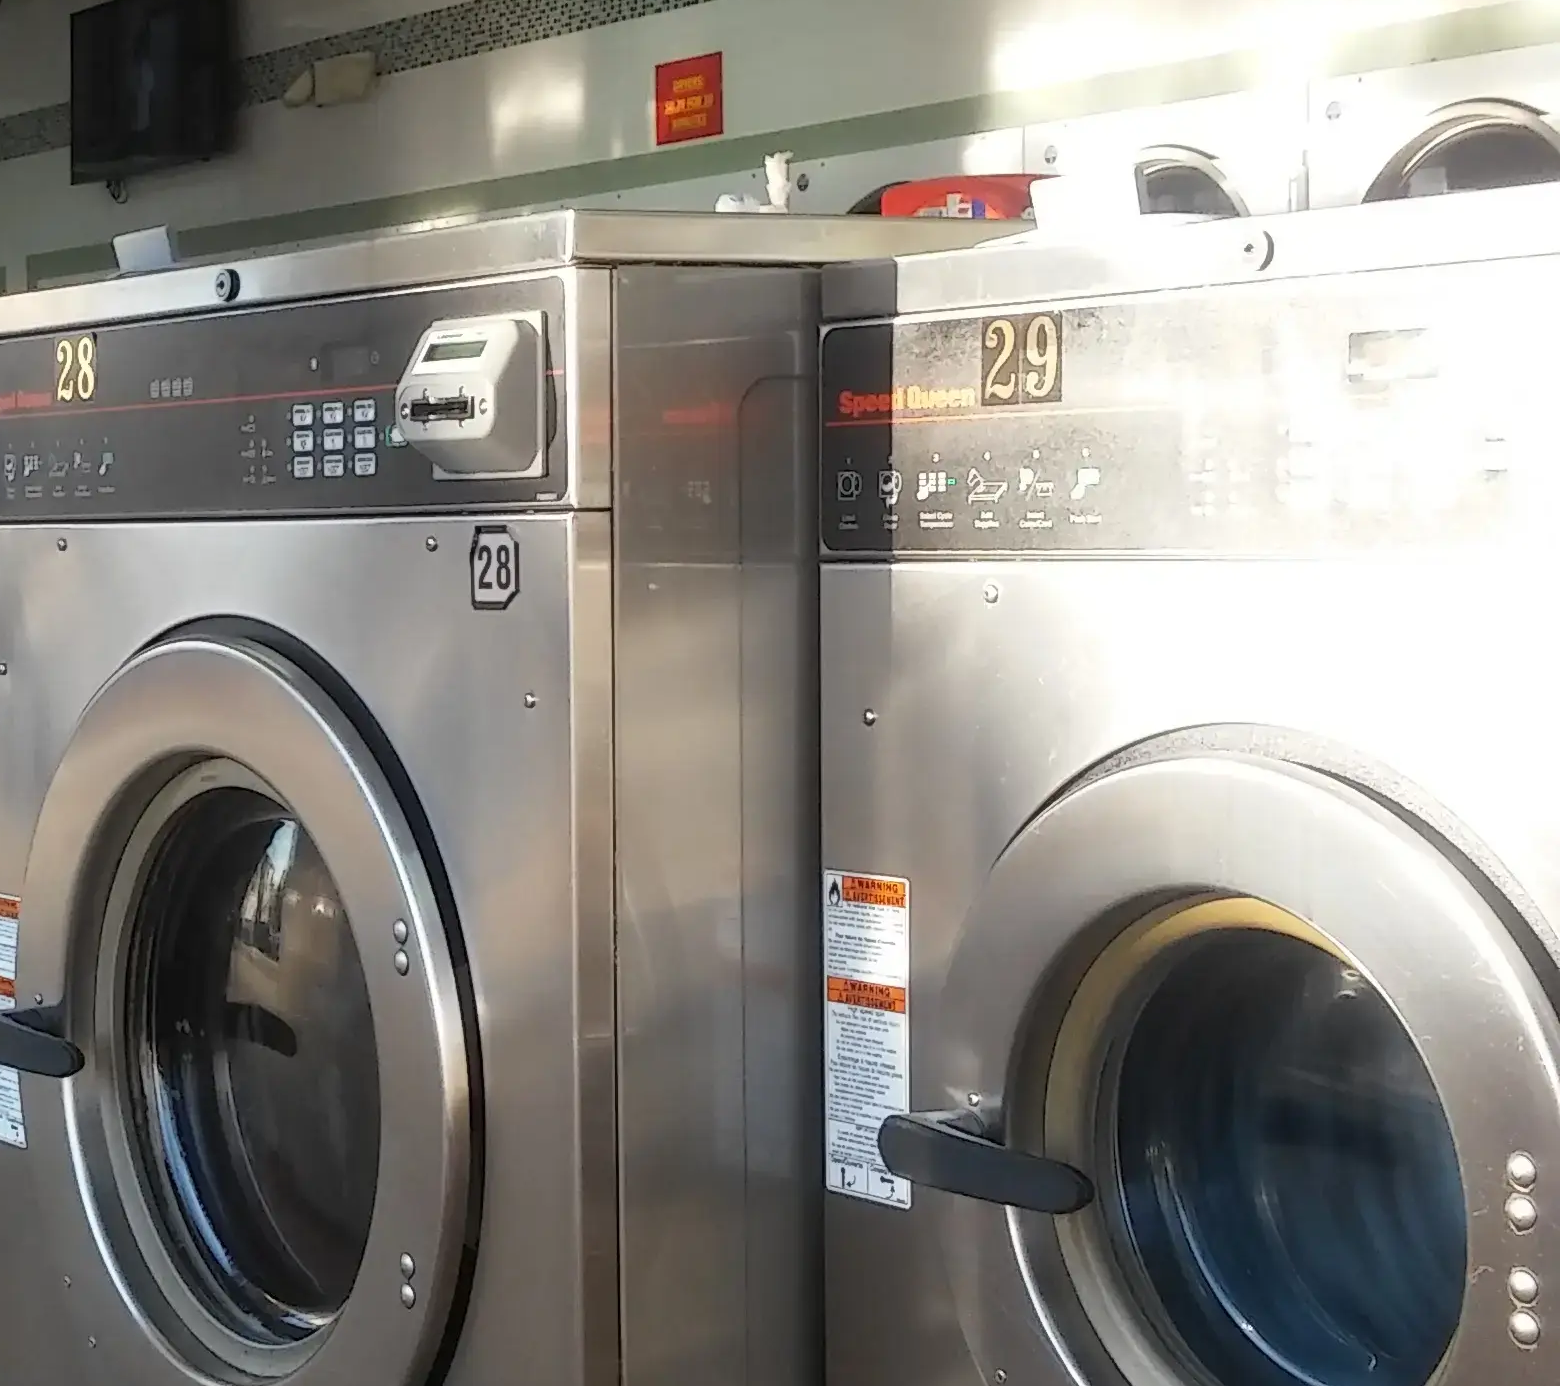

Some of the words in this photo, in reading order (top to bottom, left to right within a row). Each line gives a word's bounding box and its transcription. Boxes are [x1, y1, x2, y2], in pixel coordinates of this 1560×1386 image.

[56, 336, 96, 402] 28
[984, 315, 1059, 400] 29
[839, 384, 905, 417] Speed
[906, 384, 977, 410] Queen
[477, 544, 511, 590] 28
[857, 878, 899, 894] WARNING
[849, 981, 890, 998] WARNING
